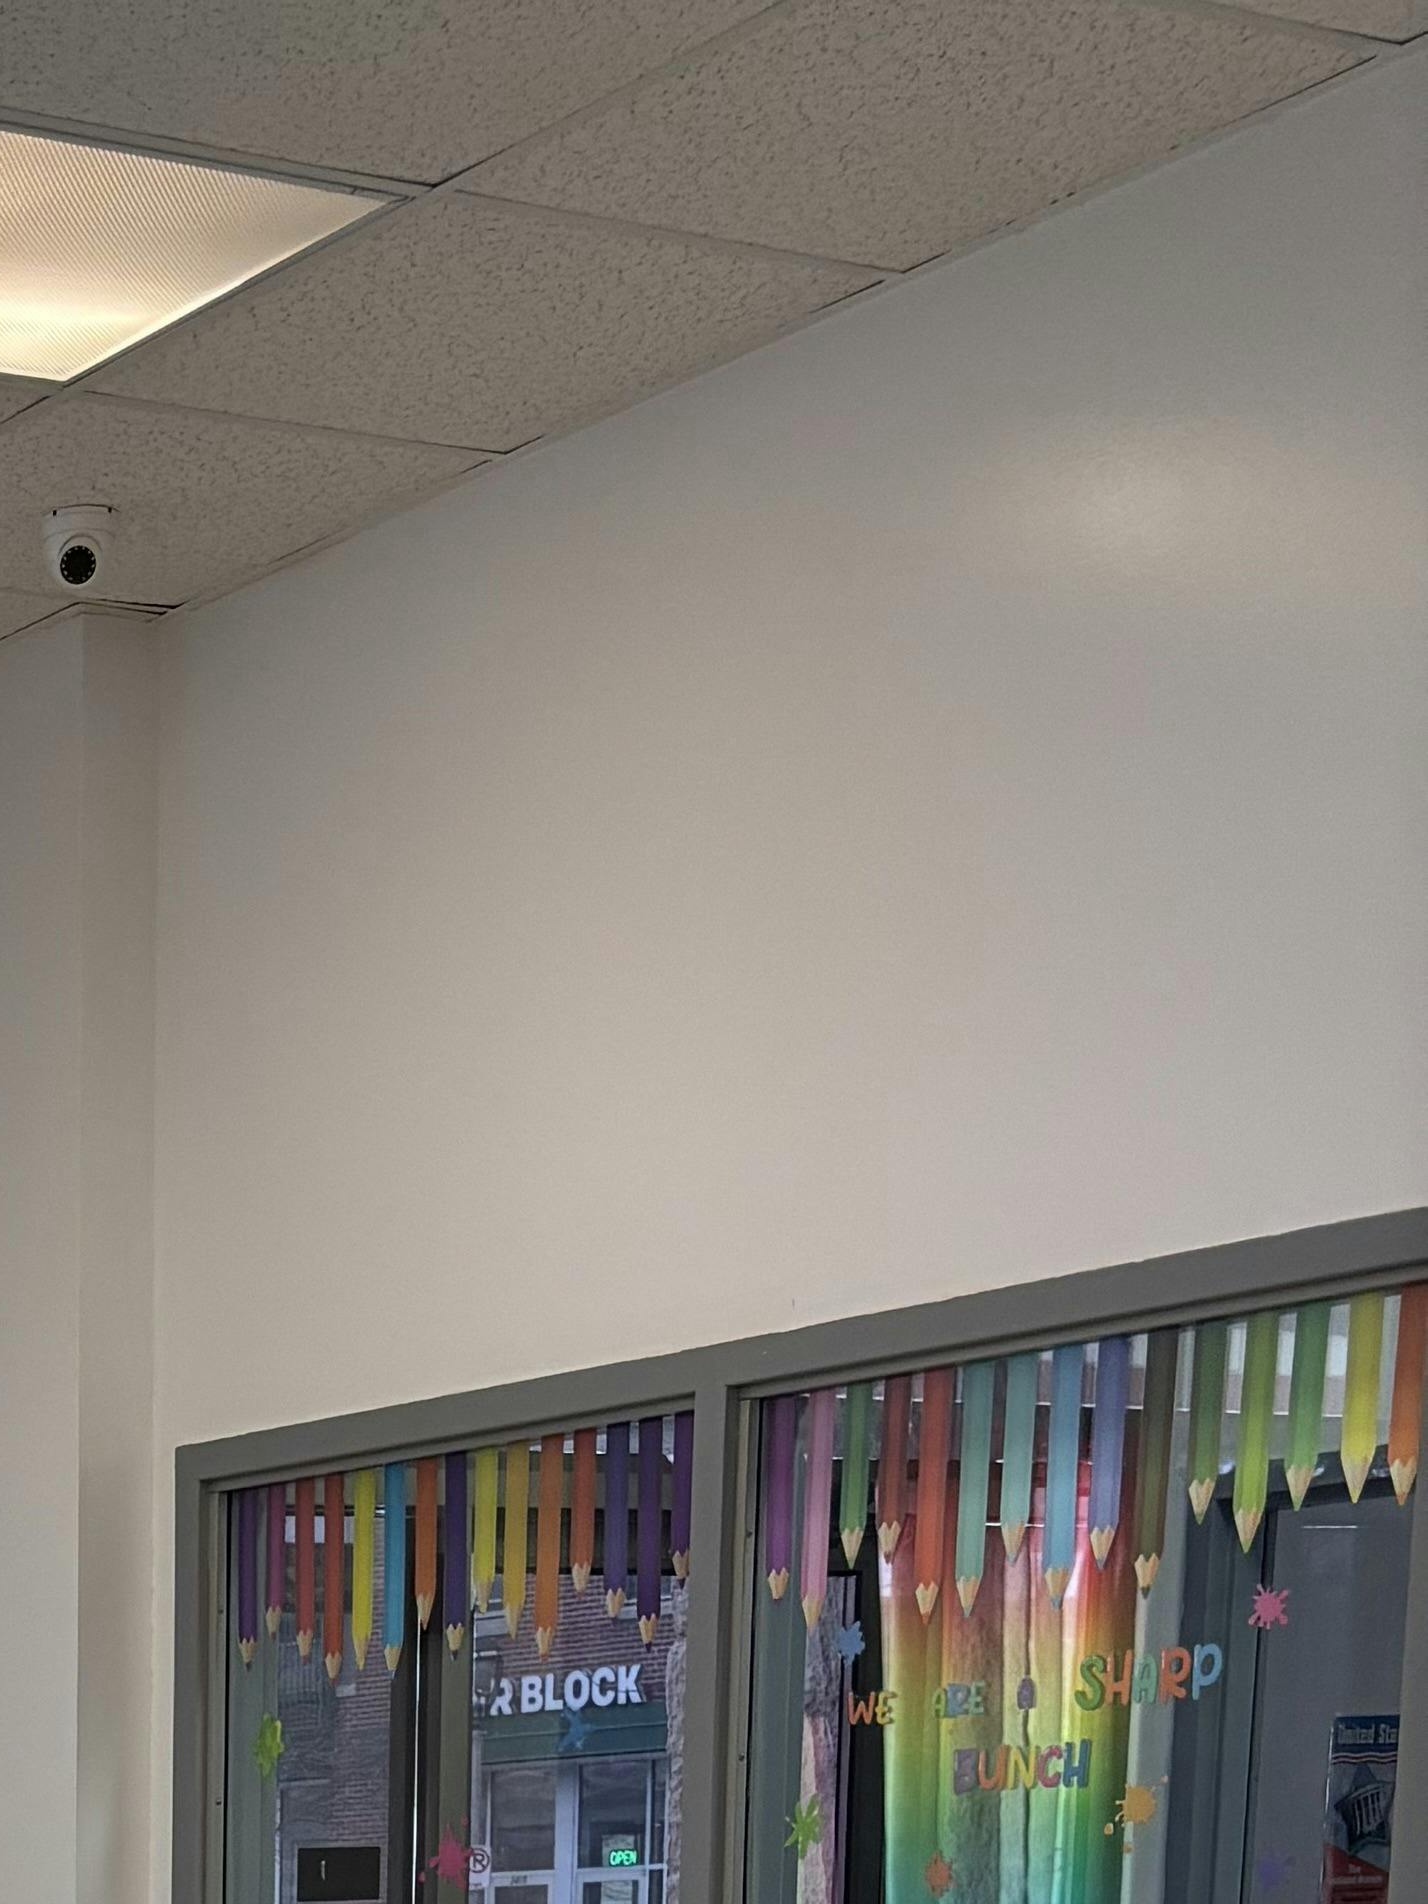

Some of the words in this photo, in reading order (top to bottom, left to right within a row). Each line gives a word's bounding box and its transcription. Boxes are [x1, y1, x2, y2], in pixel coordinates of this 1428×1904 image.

[520, 1663, 642, 1714] BLOCK
[848, 1691, 896, 1726] WE
[934, 1680, 985, 1719] ARE
[1075, 1643, 1223, 1711] SHARP
[953, 1738, 1092, 1796] BUNCH
[609, 1850, 637, 1867] OPEN
